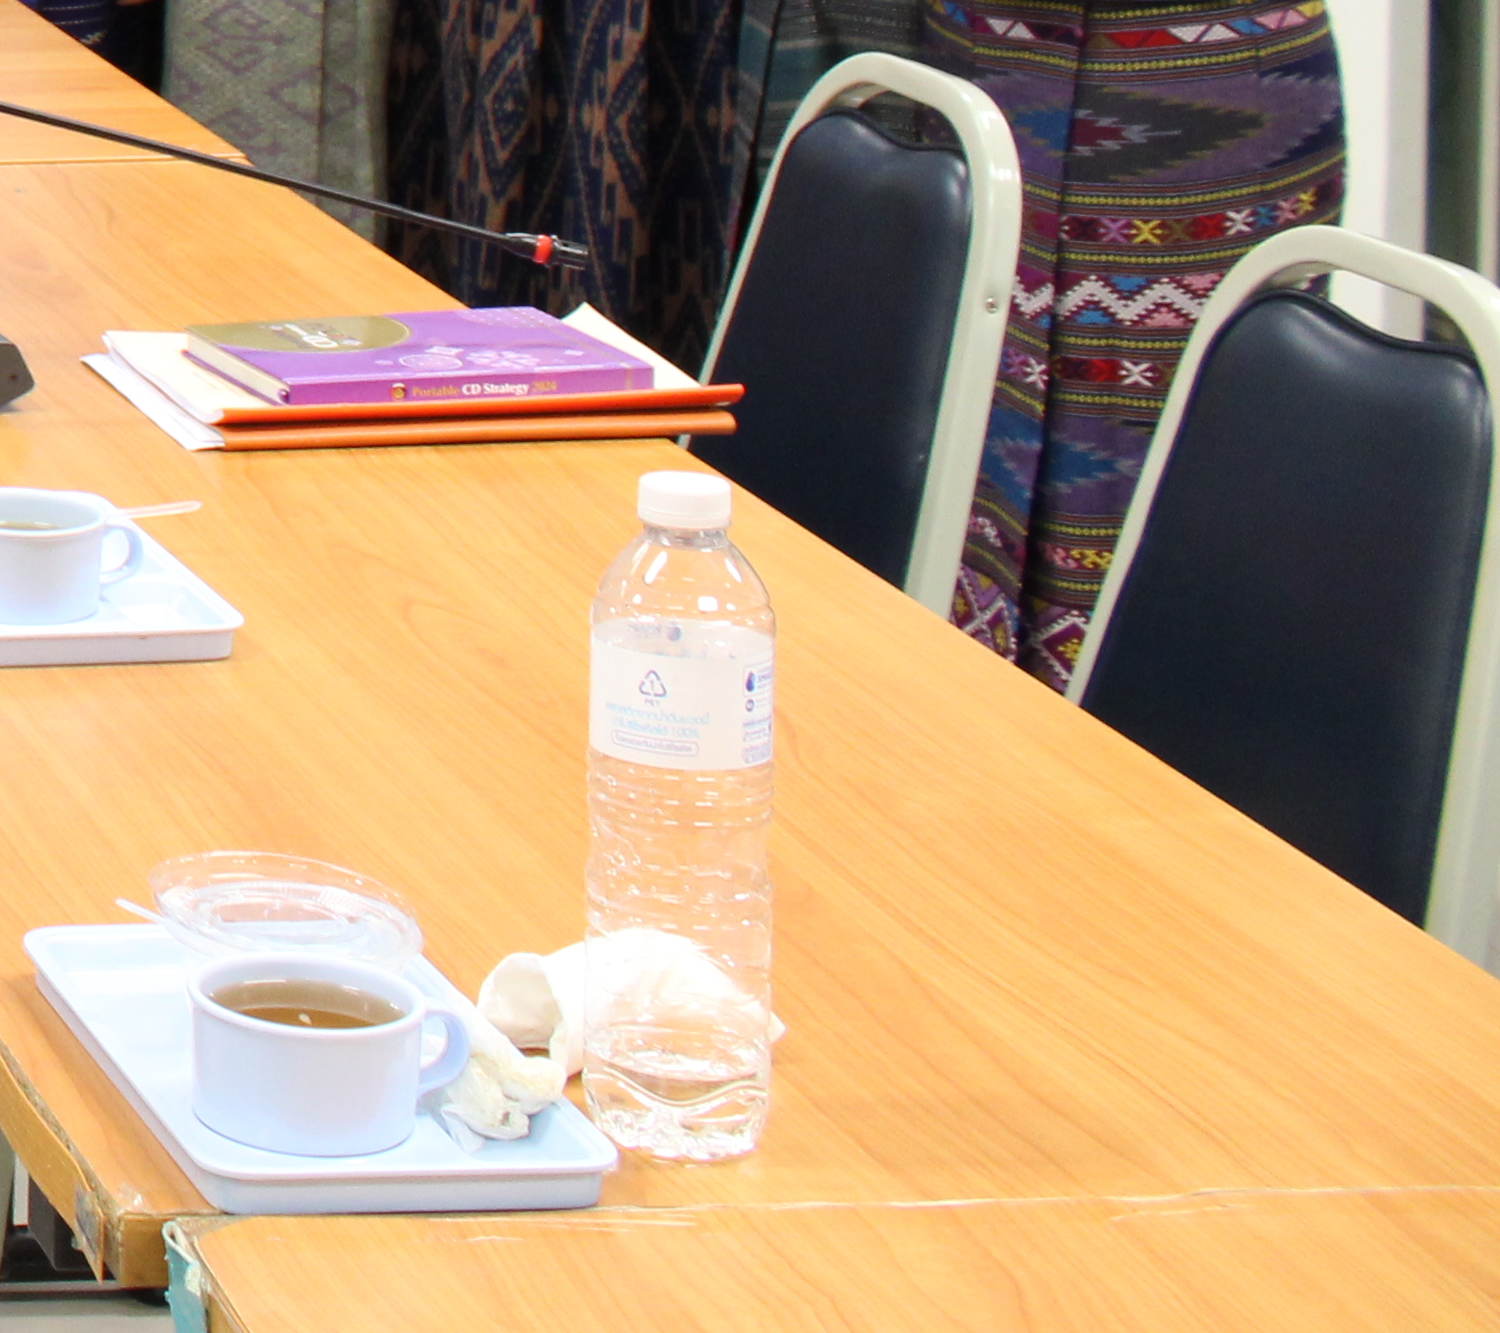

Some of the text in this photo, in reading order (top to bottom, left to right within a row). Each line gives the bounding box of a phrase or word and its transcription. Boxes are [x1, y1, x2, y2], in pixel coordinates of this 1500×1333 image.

[411, 384, 459, 398] Portable
[461, 382, 482, 396] CD
[482, 380, 529, 397] Strategy
